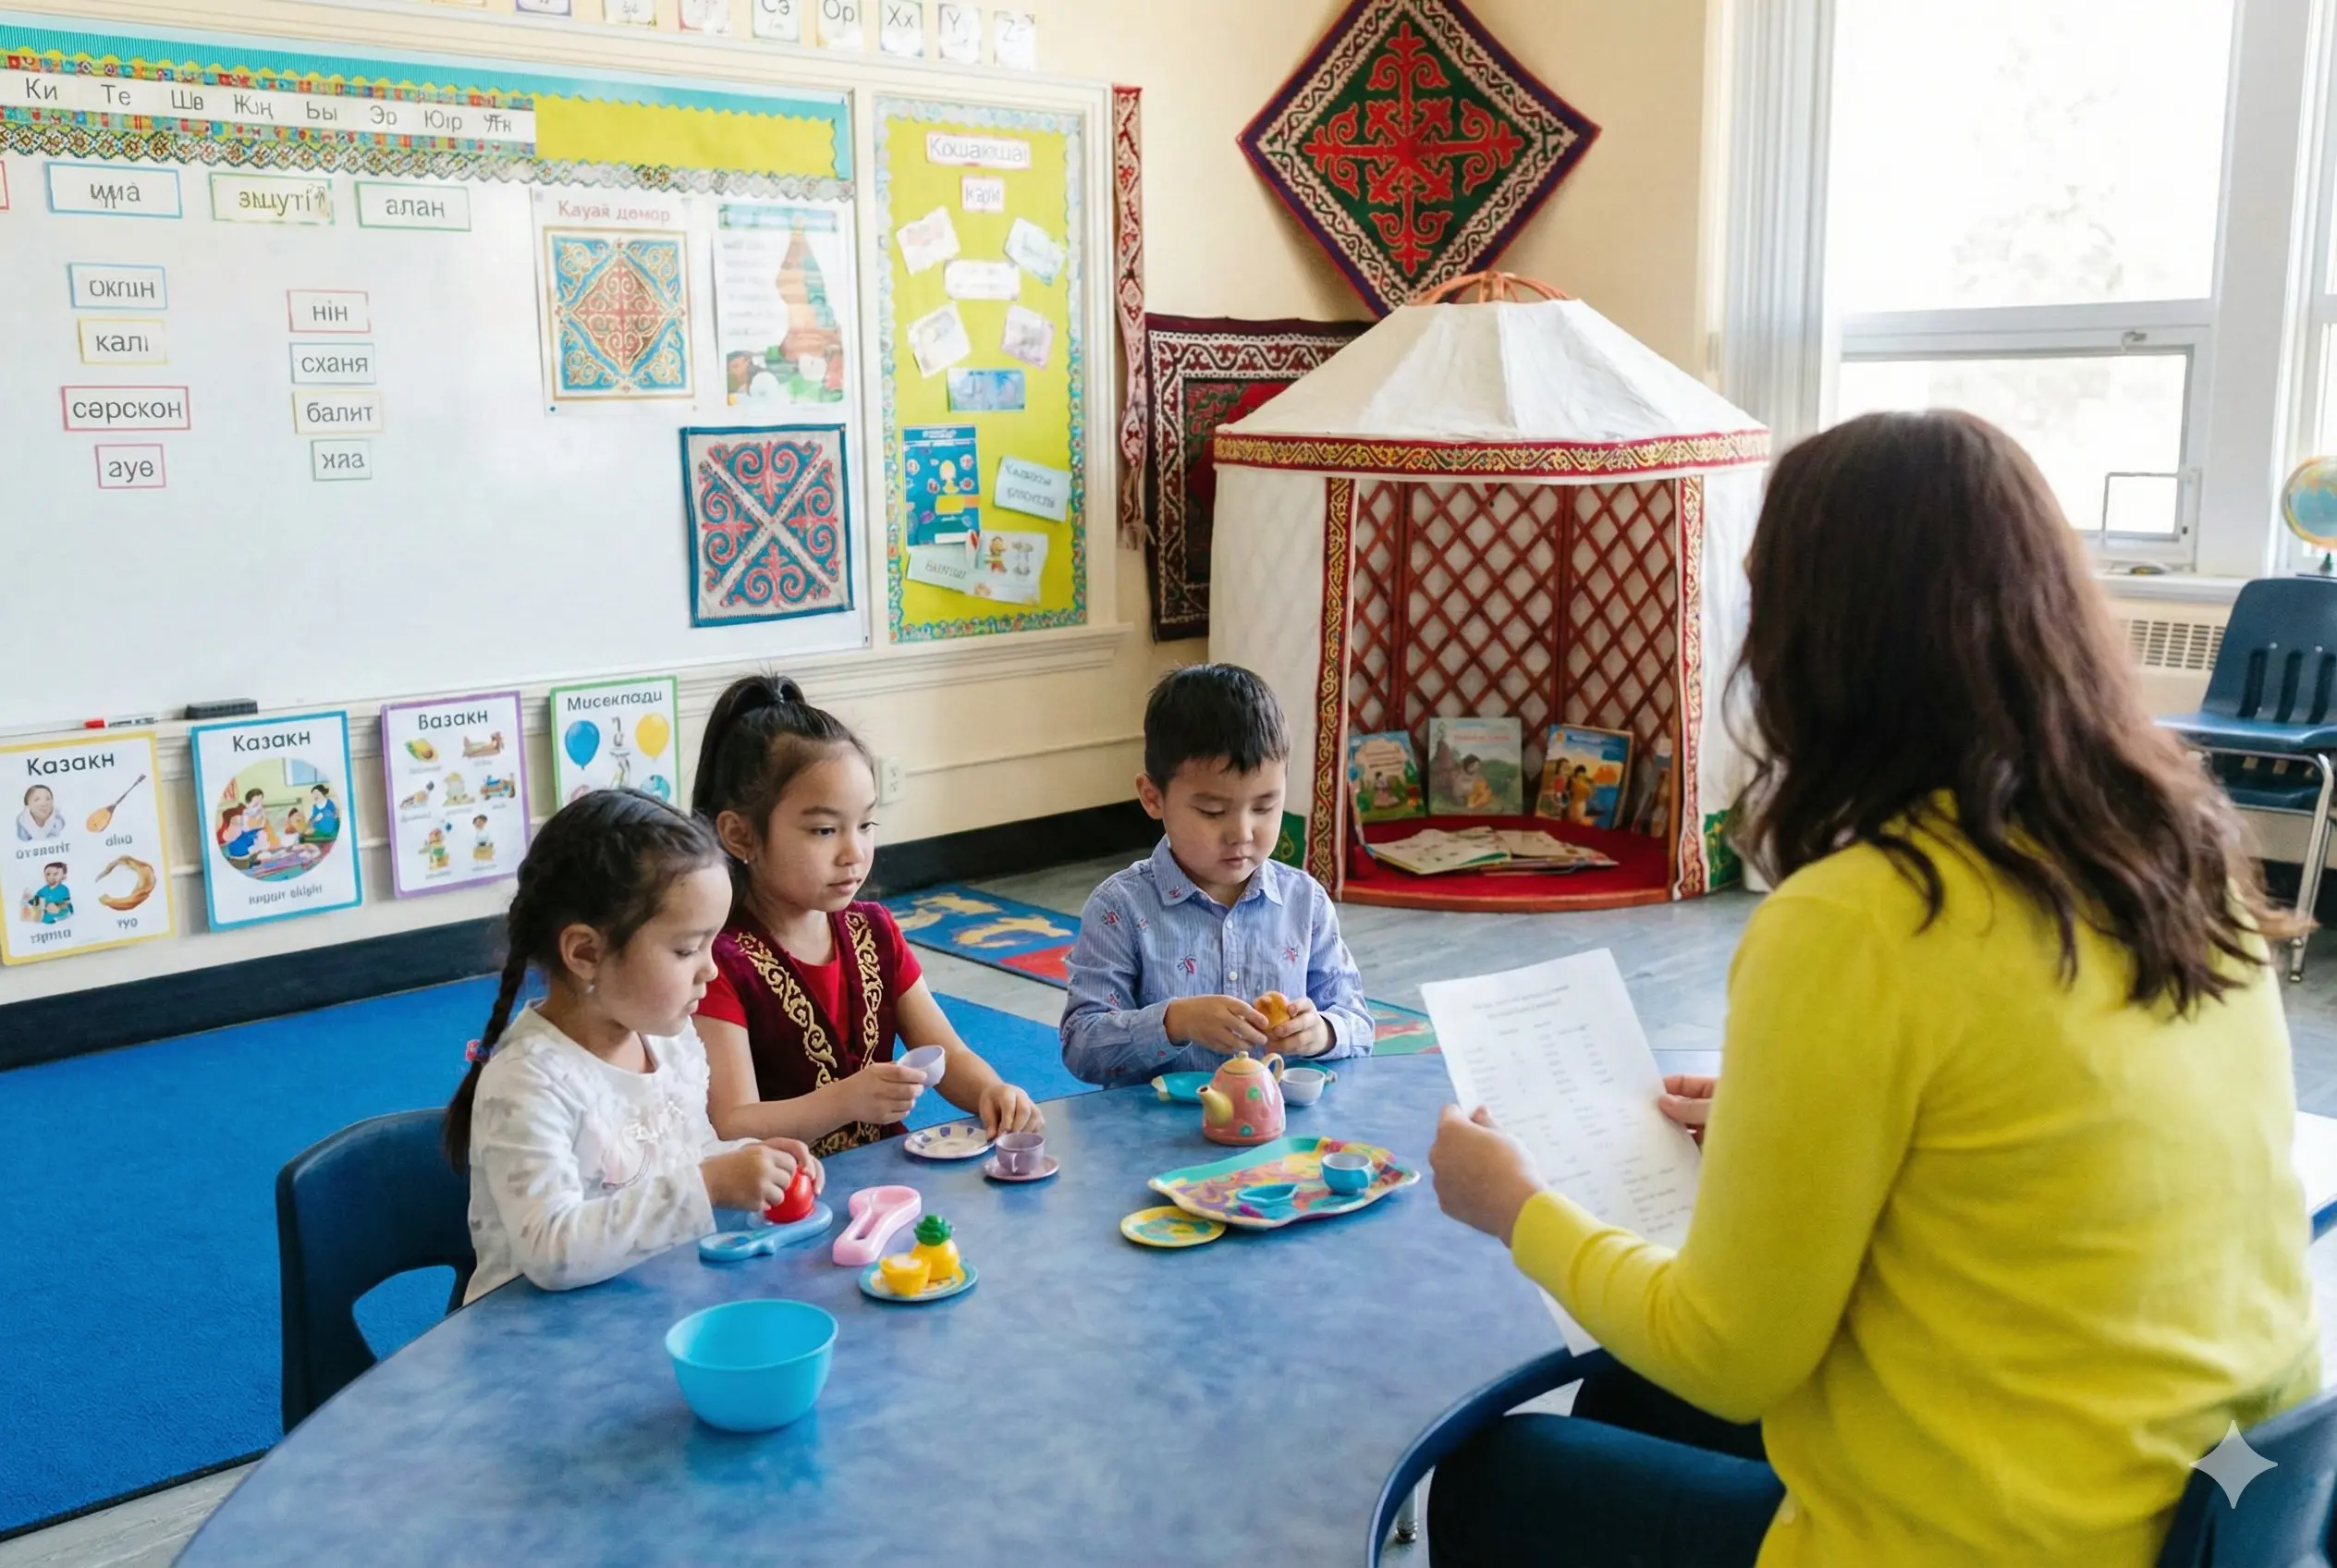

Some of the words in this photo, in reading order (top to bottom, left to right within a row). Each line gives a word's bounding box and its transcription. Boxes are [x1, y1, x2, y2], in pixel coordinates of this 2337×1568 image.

[25, 77, 58, 101] Ки
[101, 84, 131, 106] Те
[385, 197, 446, 218] алан
[232, 730, 311, 753] Казакн
[26, 752, 115, 778] Казакн
